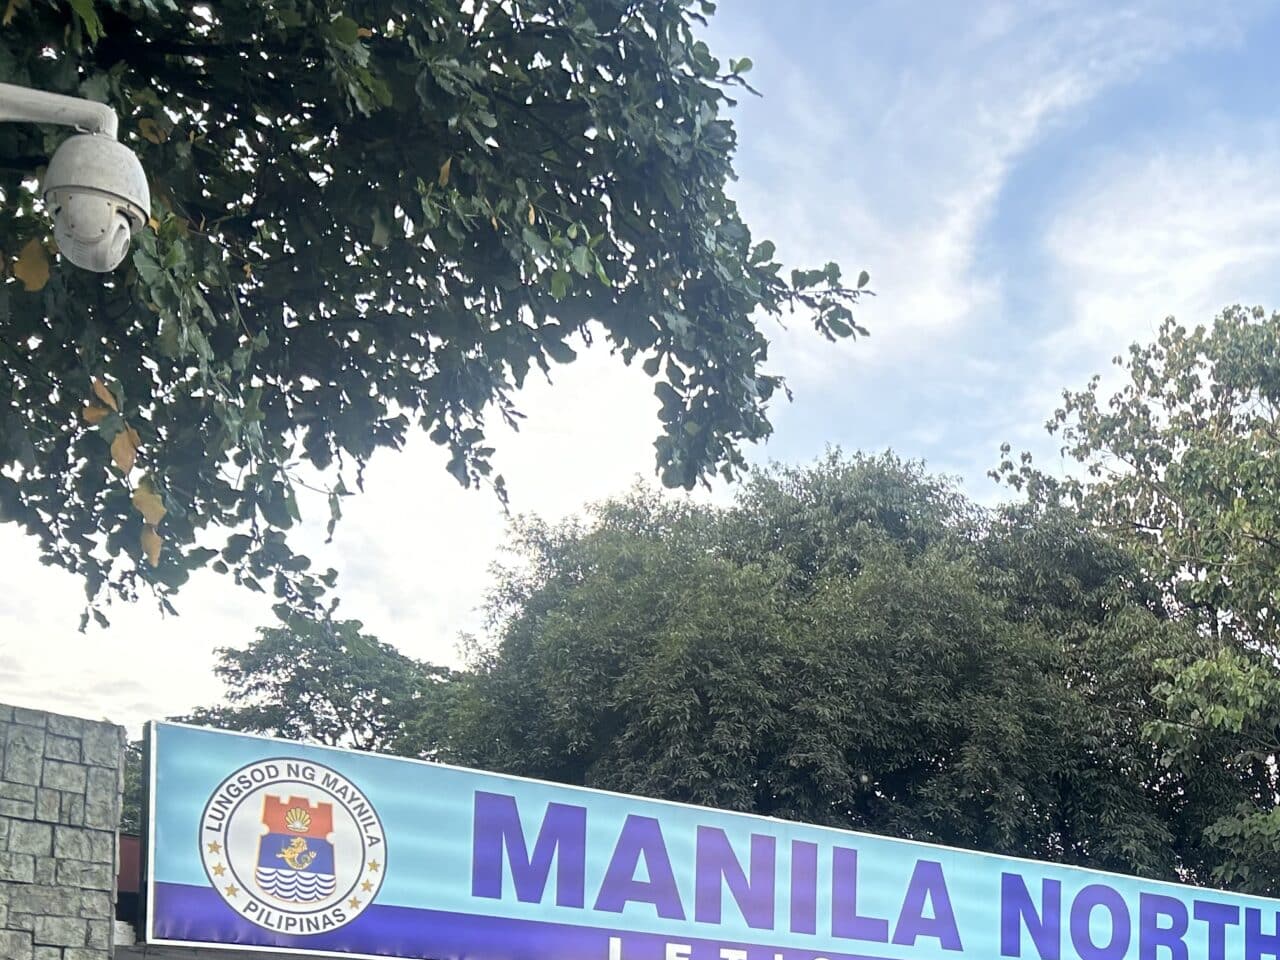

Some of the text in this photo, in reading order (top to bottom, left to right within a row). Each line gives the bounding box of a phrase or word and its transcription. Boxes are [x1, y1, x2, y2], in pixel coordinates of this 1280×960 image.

[205, 763, 382, 850] LUNGSOD NG MAYNILA
[471, 790, 963, 952] MANILA
[242, 899, 347, 933] PILIPINAS
